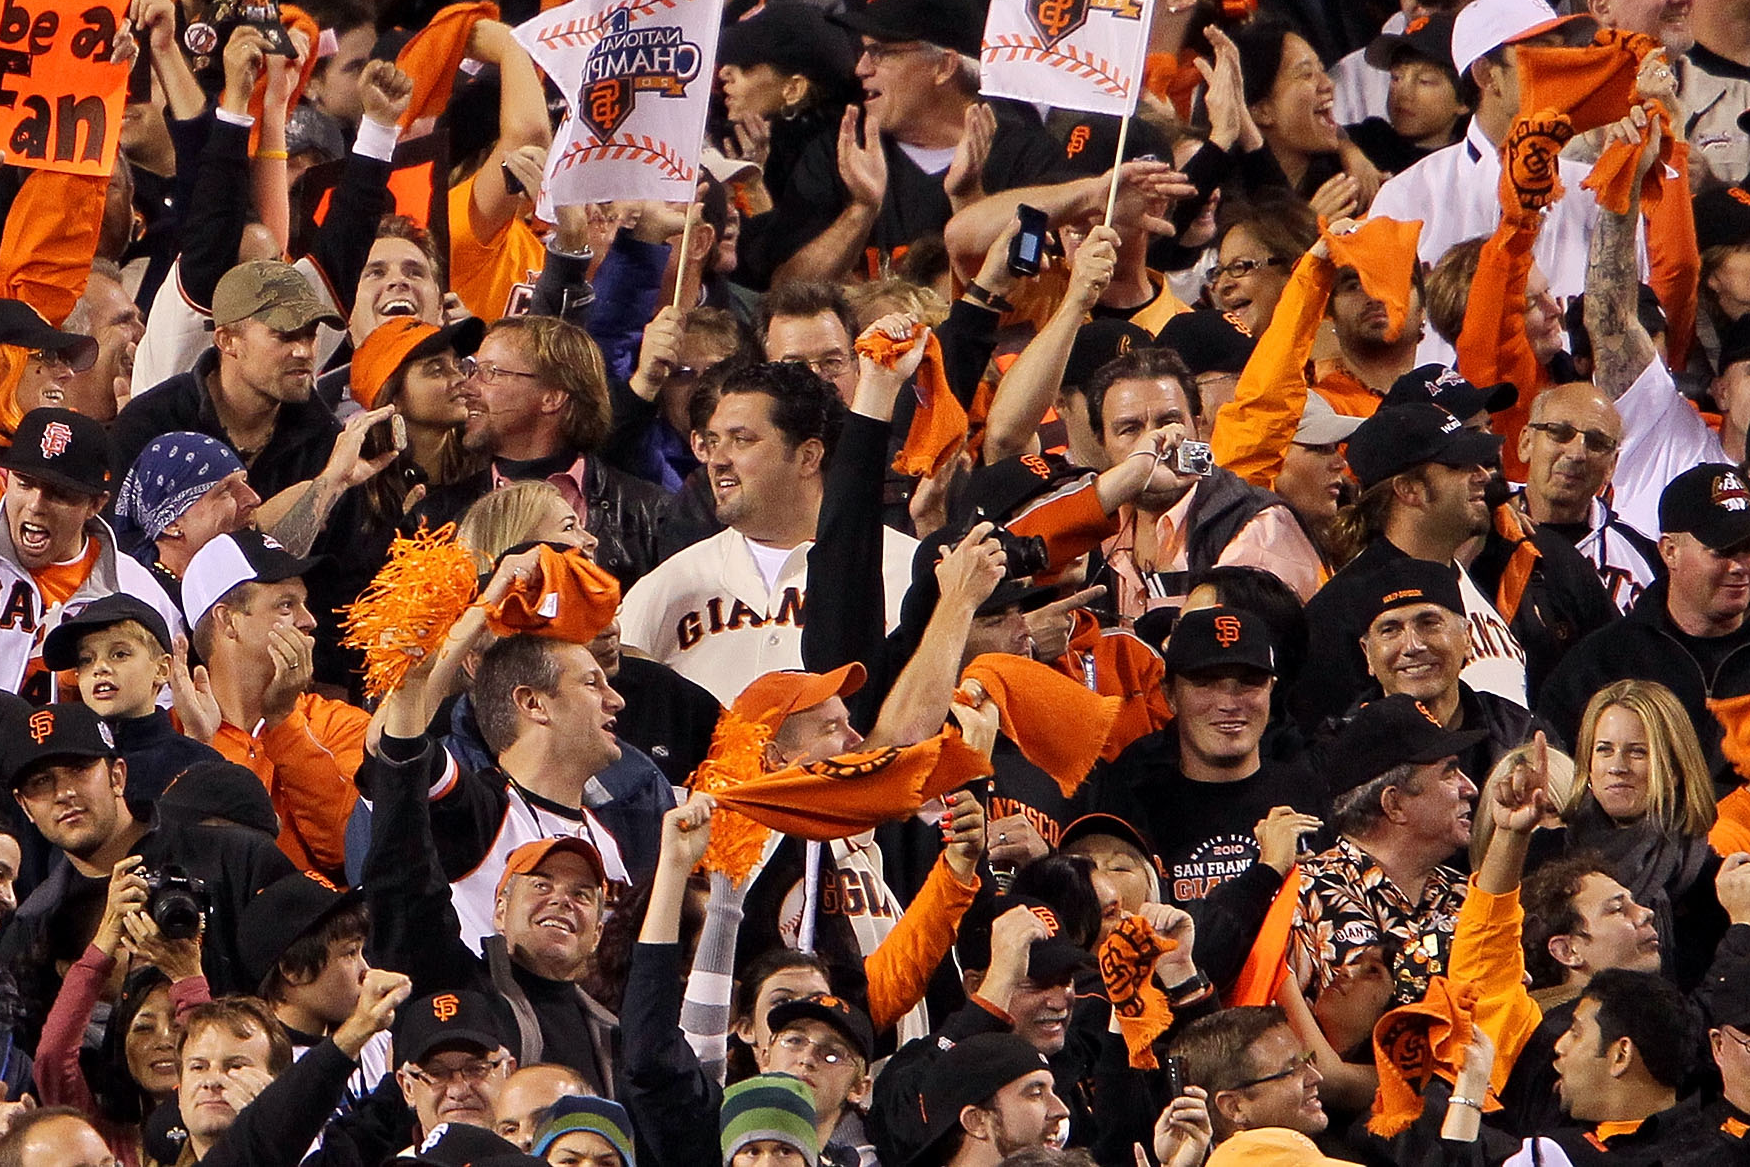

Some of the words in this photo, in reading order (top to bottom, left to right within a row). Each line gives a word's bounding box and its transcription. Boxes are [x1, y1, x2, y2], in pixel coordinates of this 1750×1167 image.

[70, 5, 118, 63] a
[1068, 124, 1091, 160] SF
[1021, 453, 1052, 481] SF
[1216, 616, 1243, 648] SF
[30, 711, 55, 746] SF
[1212, 844, 1245, 856] 2010
[1173, 862, 1205, 878] SAN
[434, 994, 459, 1022] SF
